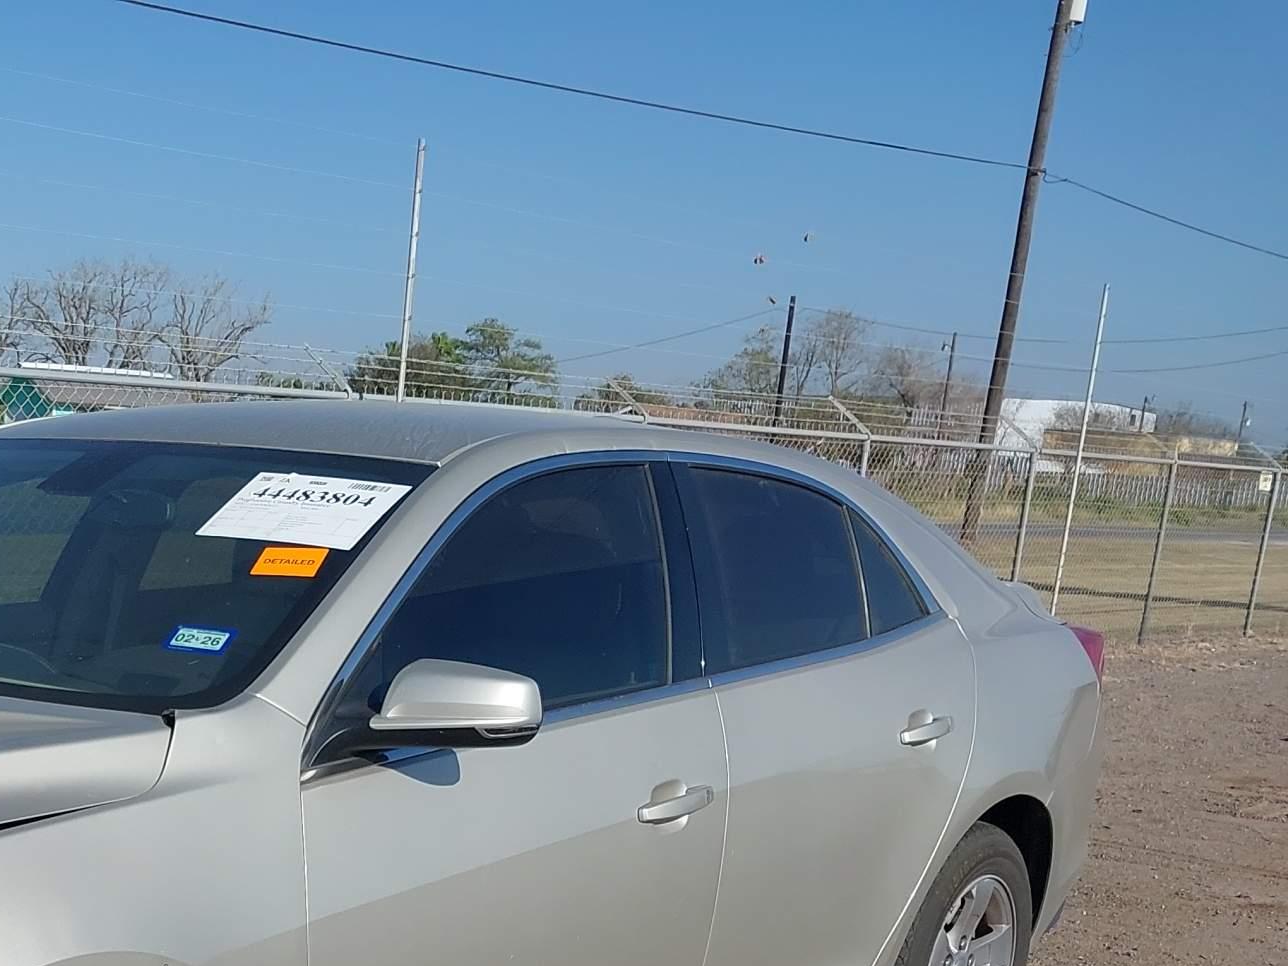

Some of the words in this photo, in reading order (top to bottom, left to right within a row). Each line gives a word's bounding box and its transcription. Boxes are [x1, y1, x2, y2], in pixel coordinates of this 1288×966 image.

[252, 486, 376, 508] 44483804
[263, 558, 316, 566] DETAILED
[174, 633, 195, 644] 02
[199, 635, 222, 647] 26
